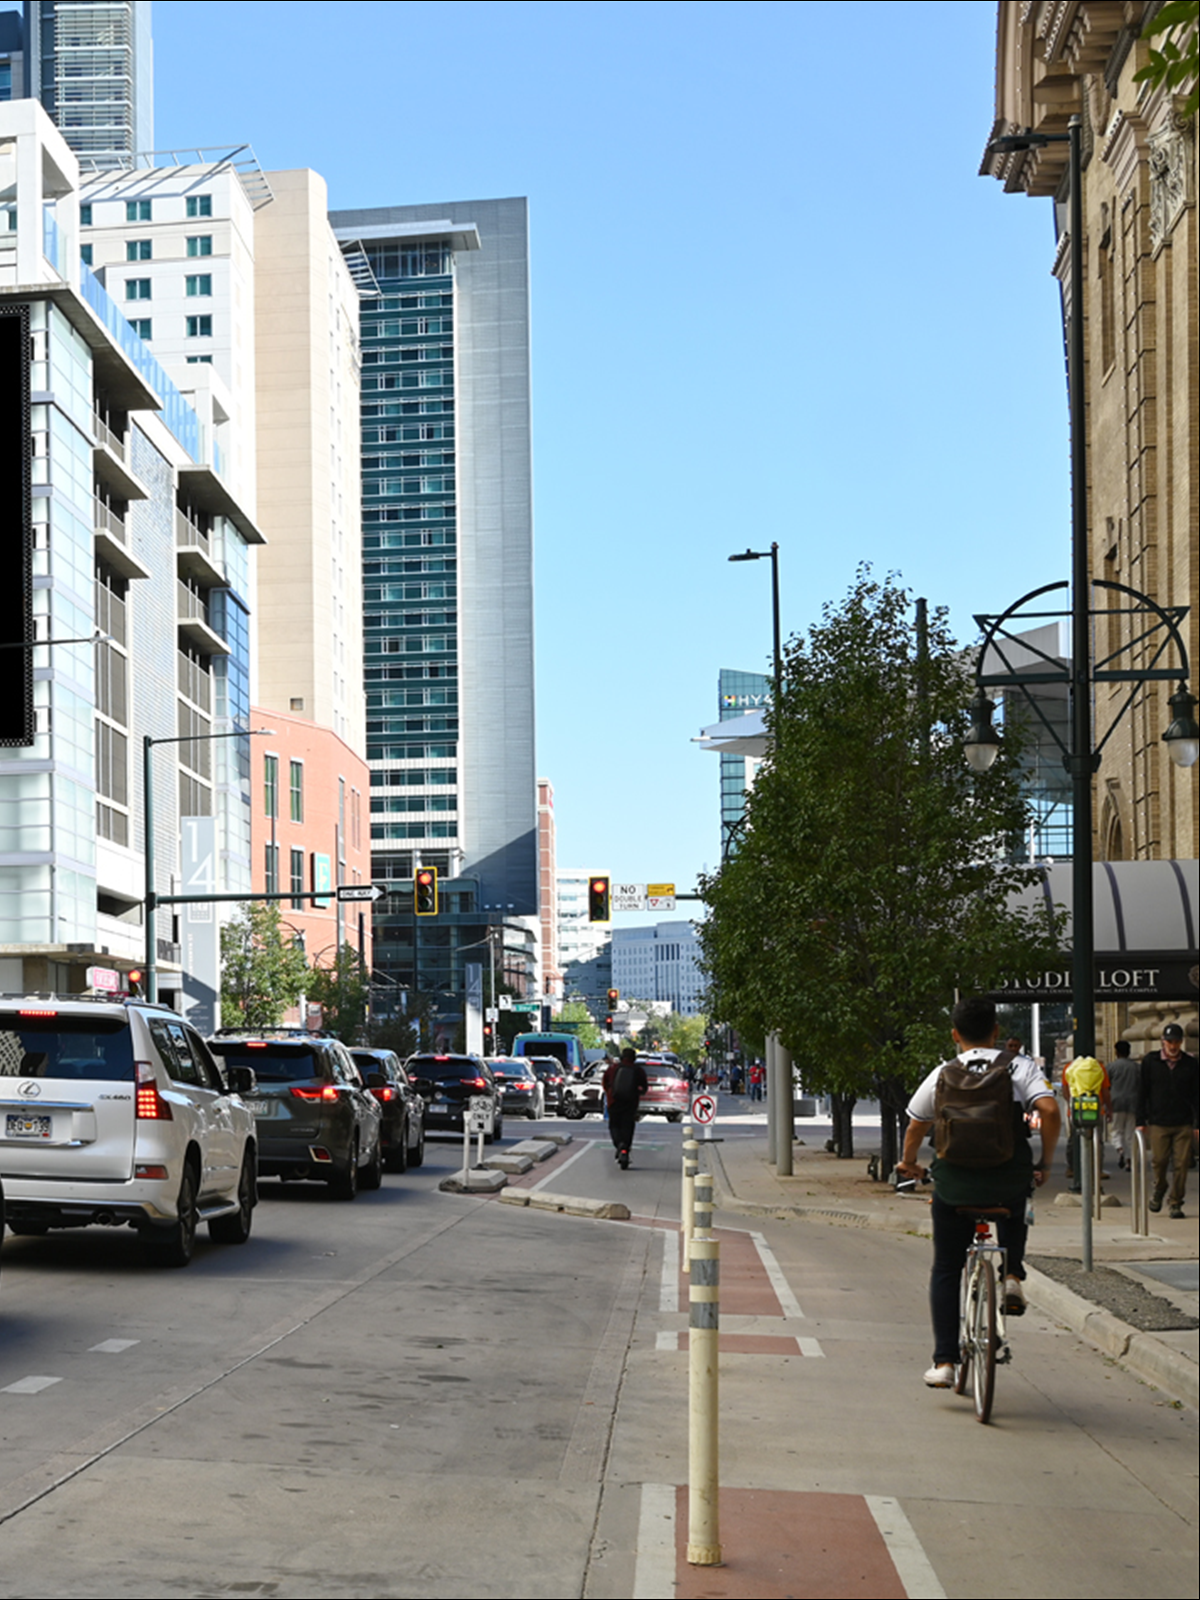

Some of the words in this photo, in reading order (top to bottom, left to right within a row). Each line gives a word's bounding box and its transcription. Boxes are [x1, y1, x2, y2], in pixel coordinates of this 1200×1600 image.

[739, 694, 774, 706] HYA
[342, 890, 354, 898] ONE
[357, 889, 371, 897] WAY
[621, 885, 636, 894] NO
[1000, 971, 1071, 989] STUDI
[1099, 969, 1160, 988] LOFT
